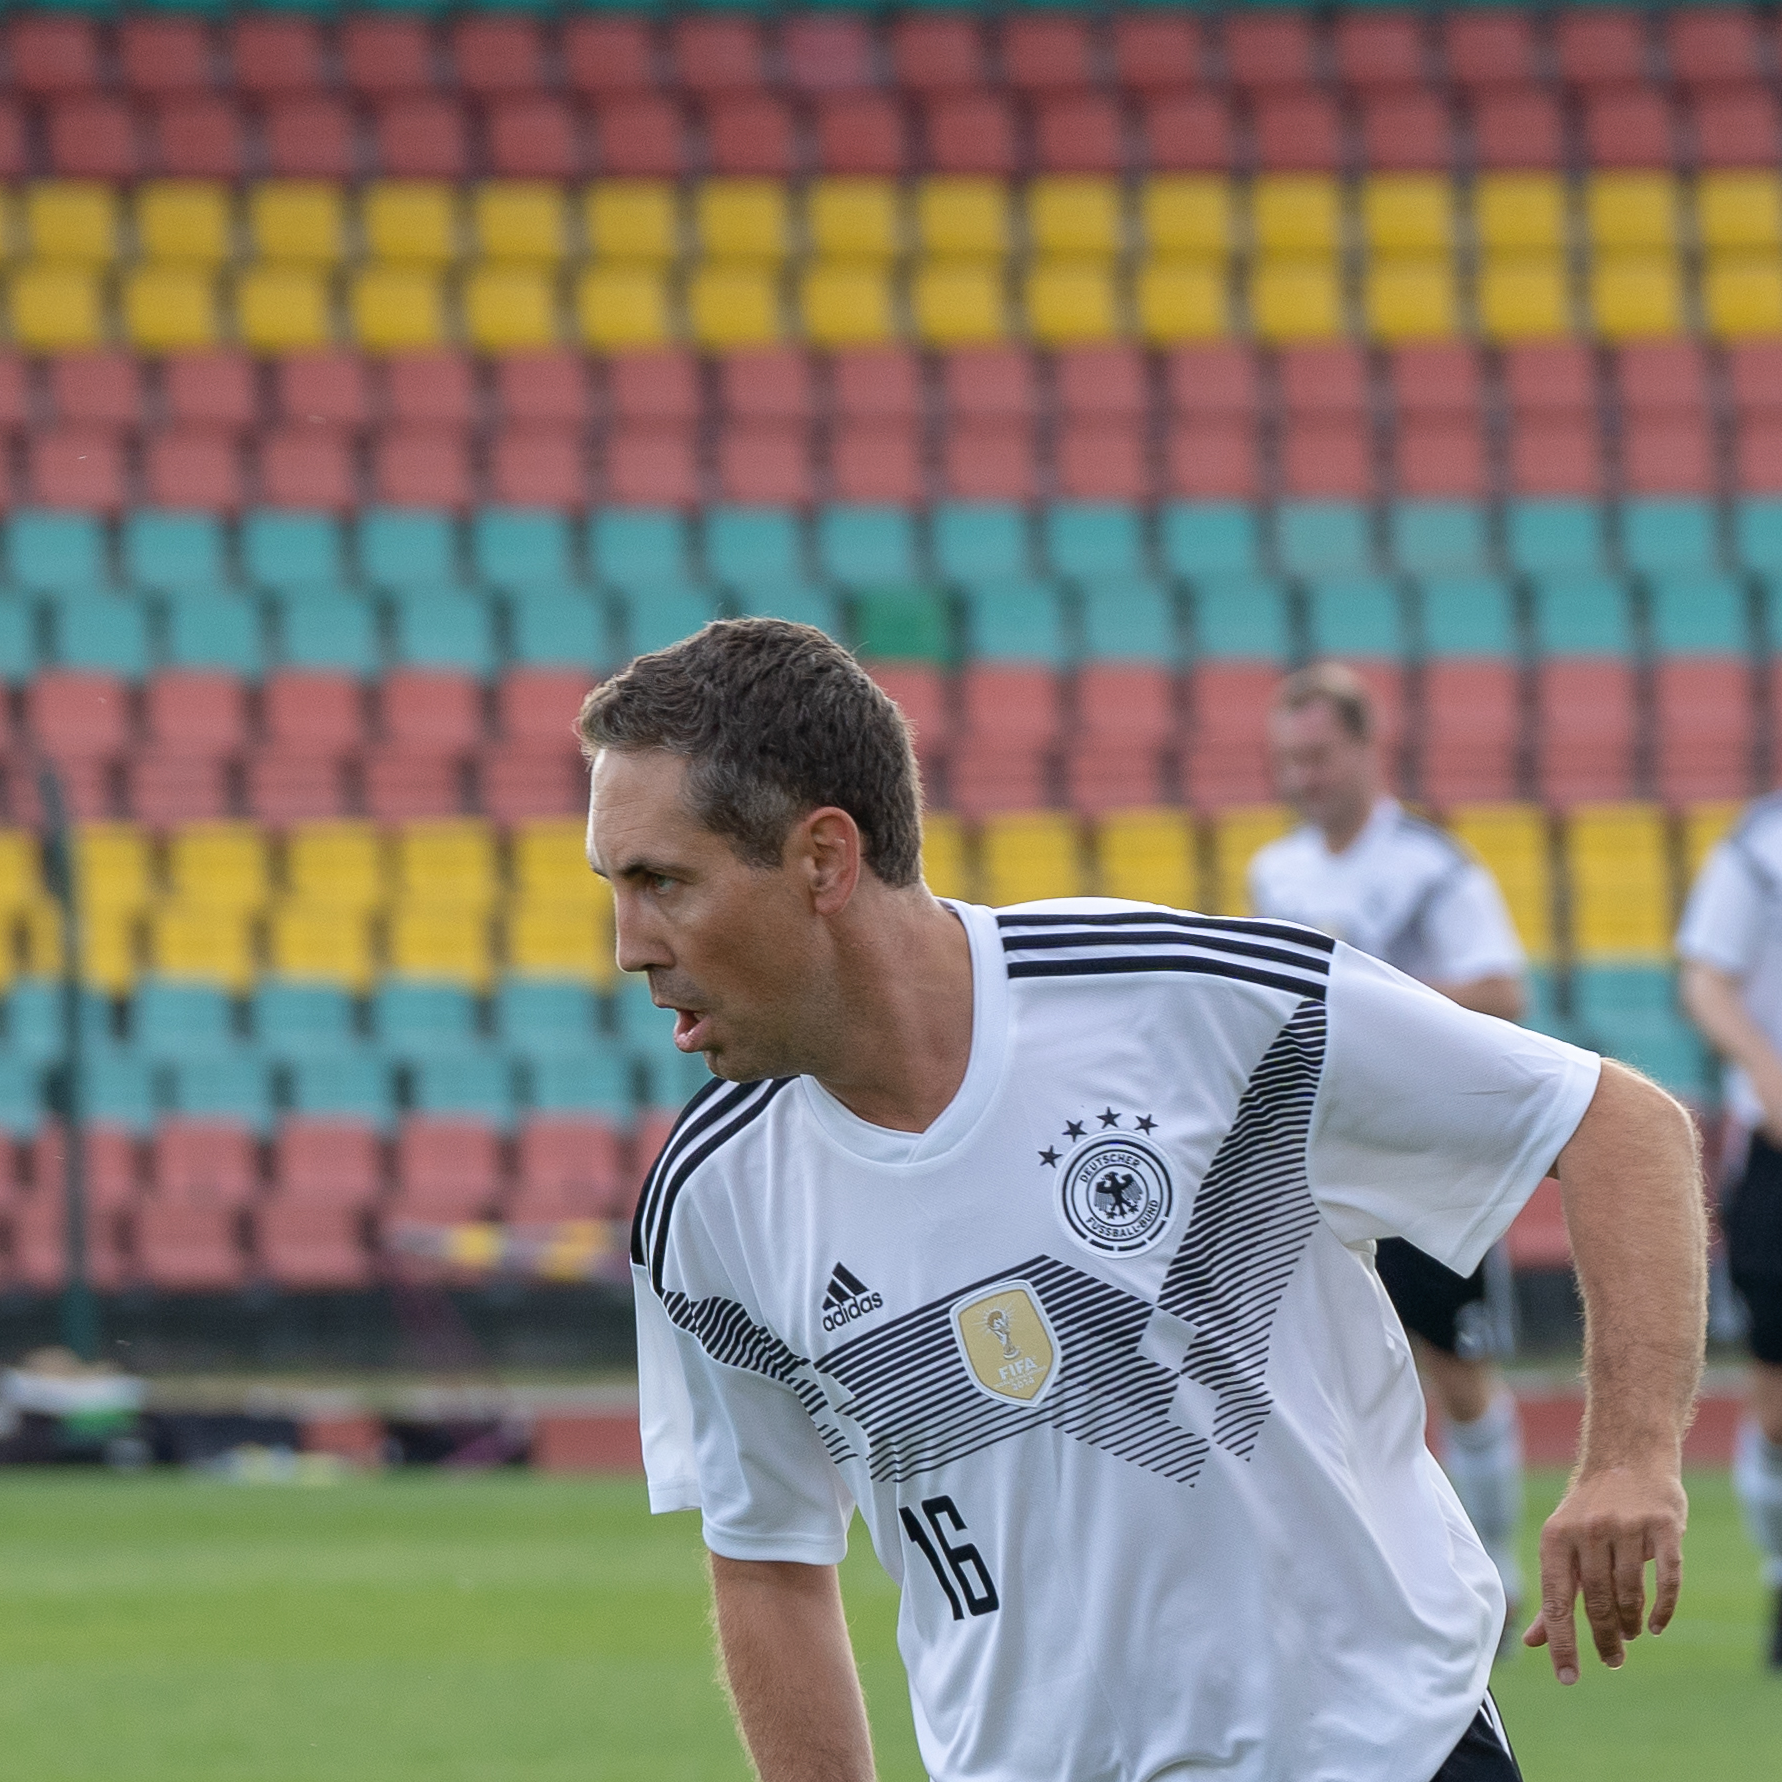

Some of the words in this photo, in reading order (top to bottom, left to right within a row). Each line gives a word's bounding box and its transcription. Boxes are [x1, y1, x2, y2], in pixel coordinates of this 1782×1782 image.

[1080, 1153, 1141, 1183] DEUTSCHER
[1086, 1199, 1159, 1238] FUSSBALL-BUND
[822, 1292, 884, 1332] adidas
[998, 1356, 1038, 1381] FIFA
[898, 1495, 1000, 1621] 16
